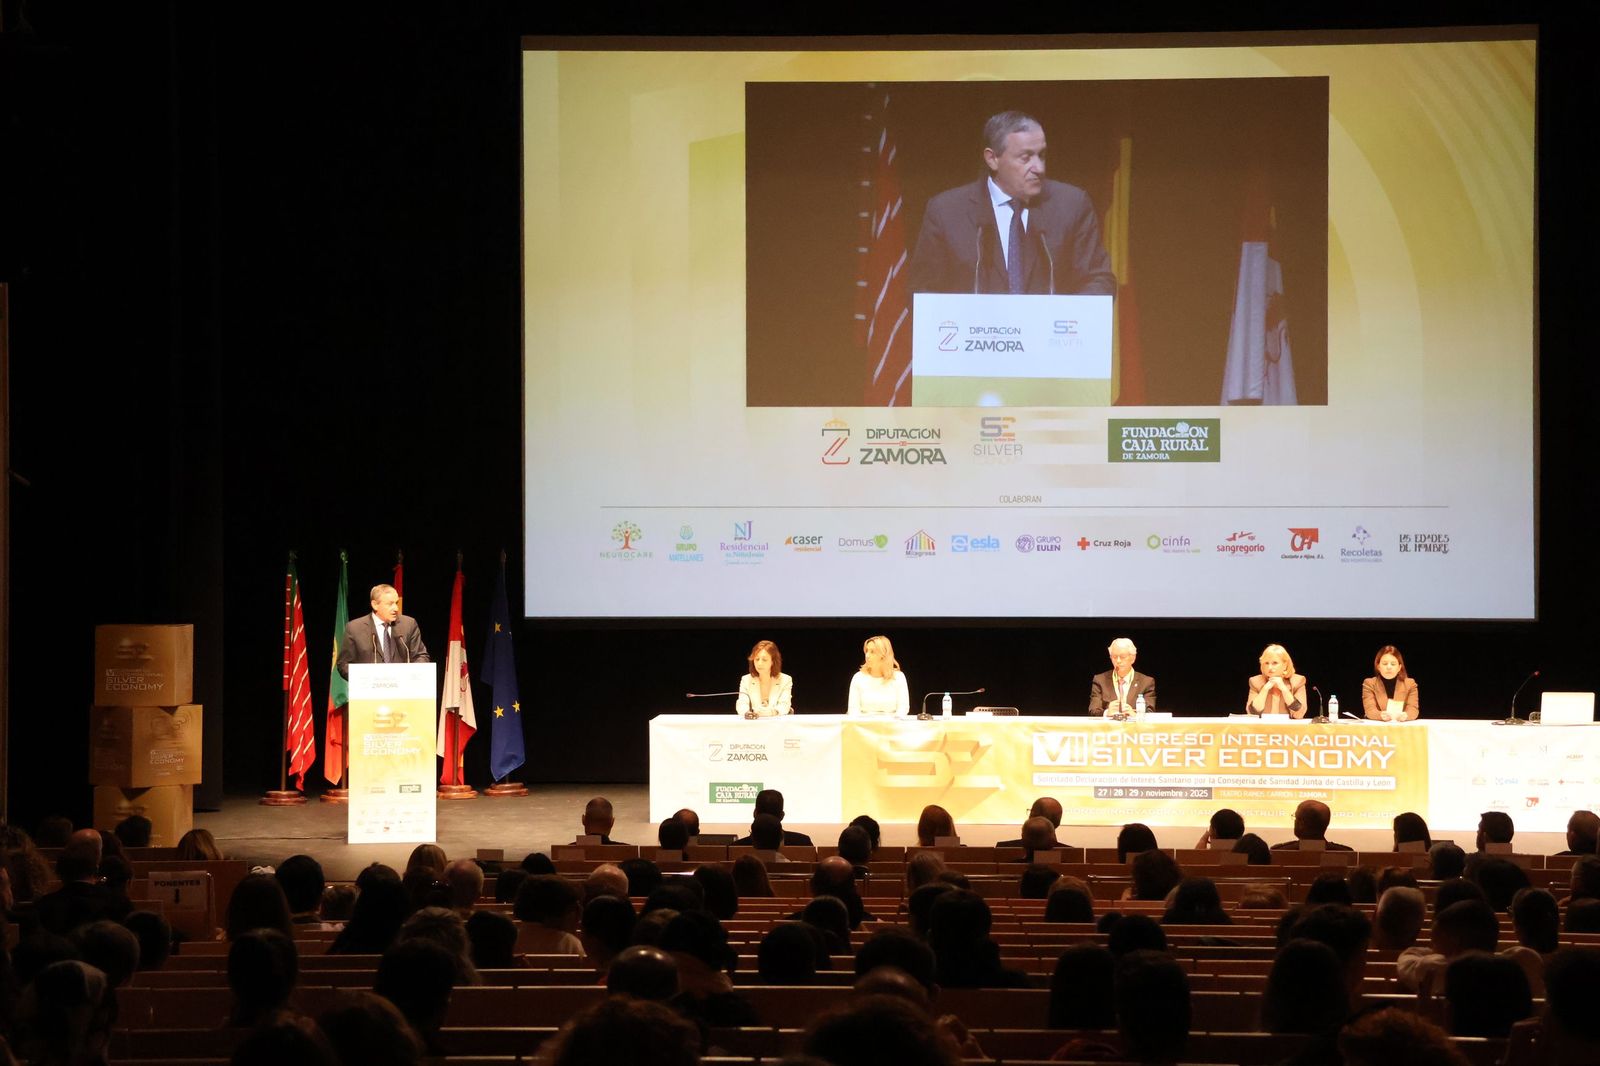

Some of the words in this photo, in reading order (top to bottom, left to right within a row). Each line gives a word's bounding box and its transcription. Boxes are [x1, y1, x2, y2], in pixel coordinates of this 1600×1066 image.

[965, 340, 1024, 352] ZAMORA
[973, 444, 1024, 456] SILVER
[1122, 439, 1156, 452] CAJA
[1160, 439, 1208, 452] RURAL
[860, 448, 948, 464] ZAMORA
[1000, 496, 1042, 504] COLABORAN
[792, 536, 823, 544] caser
[838, 537, 874, 546] Domus
[970, 536, 1000, 548] esla
[1114, 540, 1132, 548] Roja
[720, 542, 769, 551] Residencial
[1216, 544, 1265, 554] sangregorio
[1340, 548, 1382, 556] Recoletas
[1092, 733, 1213, 745] CONGRESO
[1222, 734, 1396, 748] INTERNACIONAL
[1092, 748, 1206, 767] SILVER
[1219, 749, 1395, 769] ECONOMY
[1337, 778, 1364, 786] Castilla
